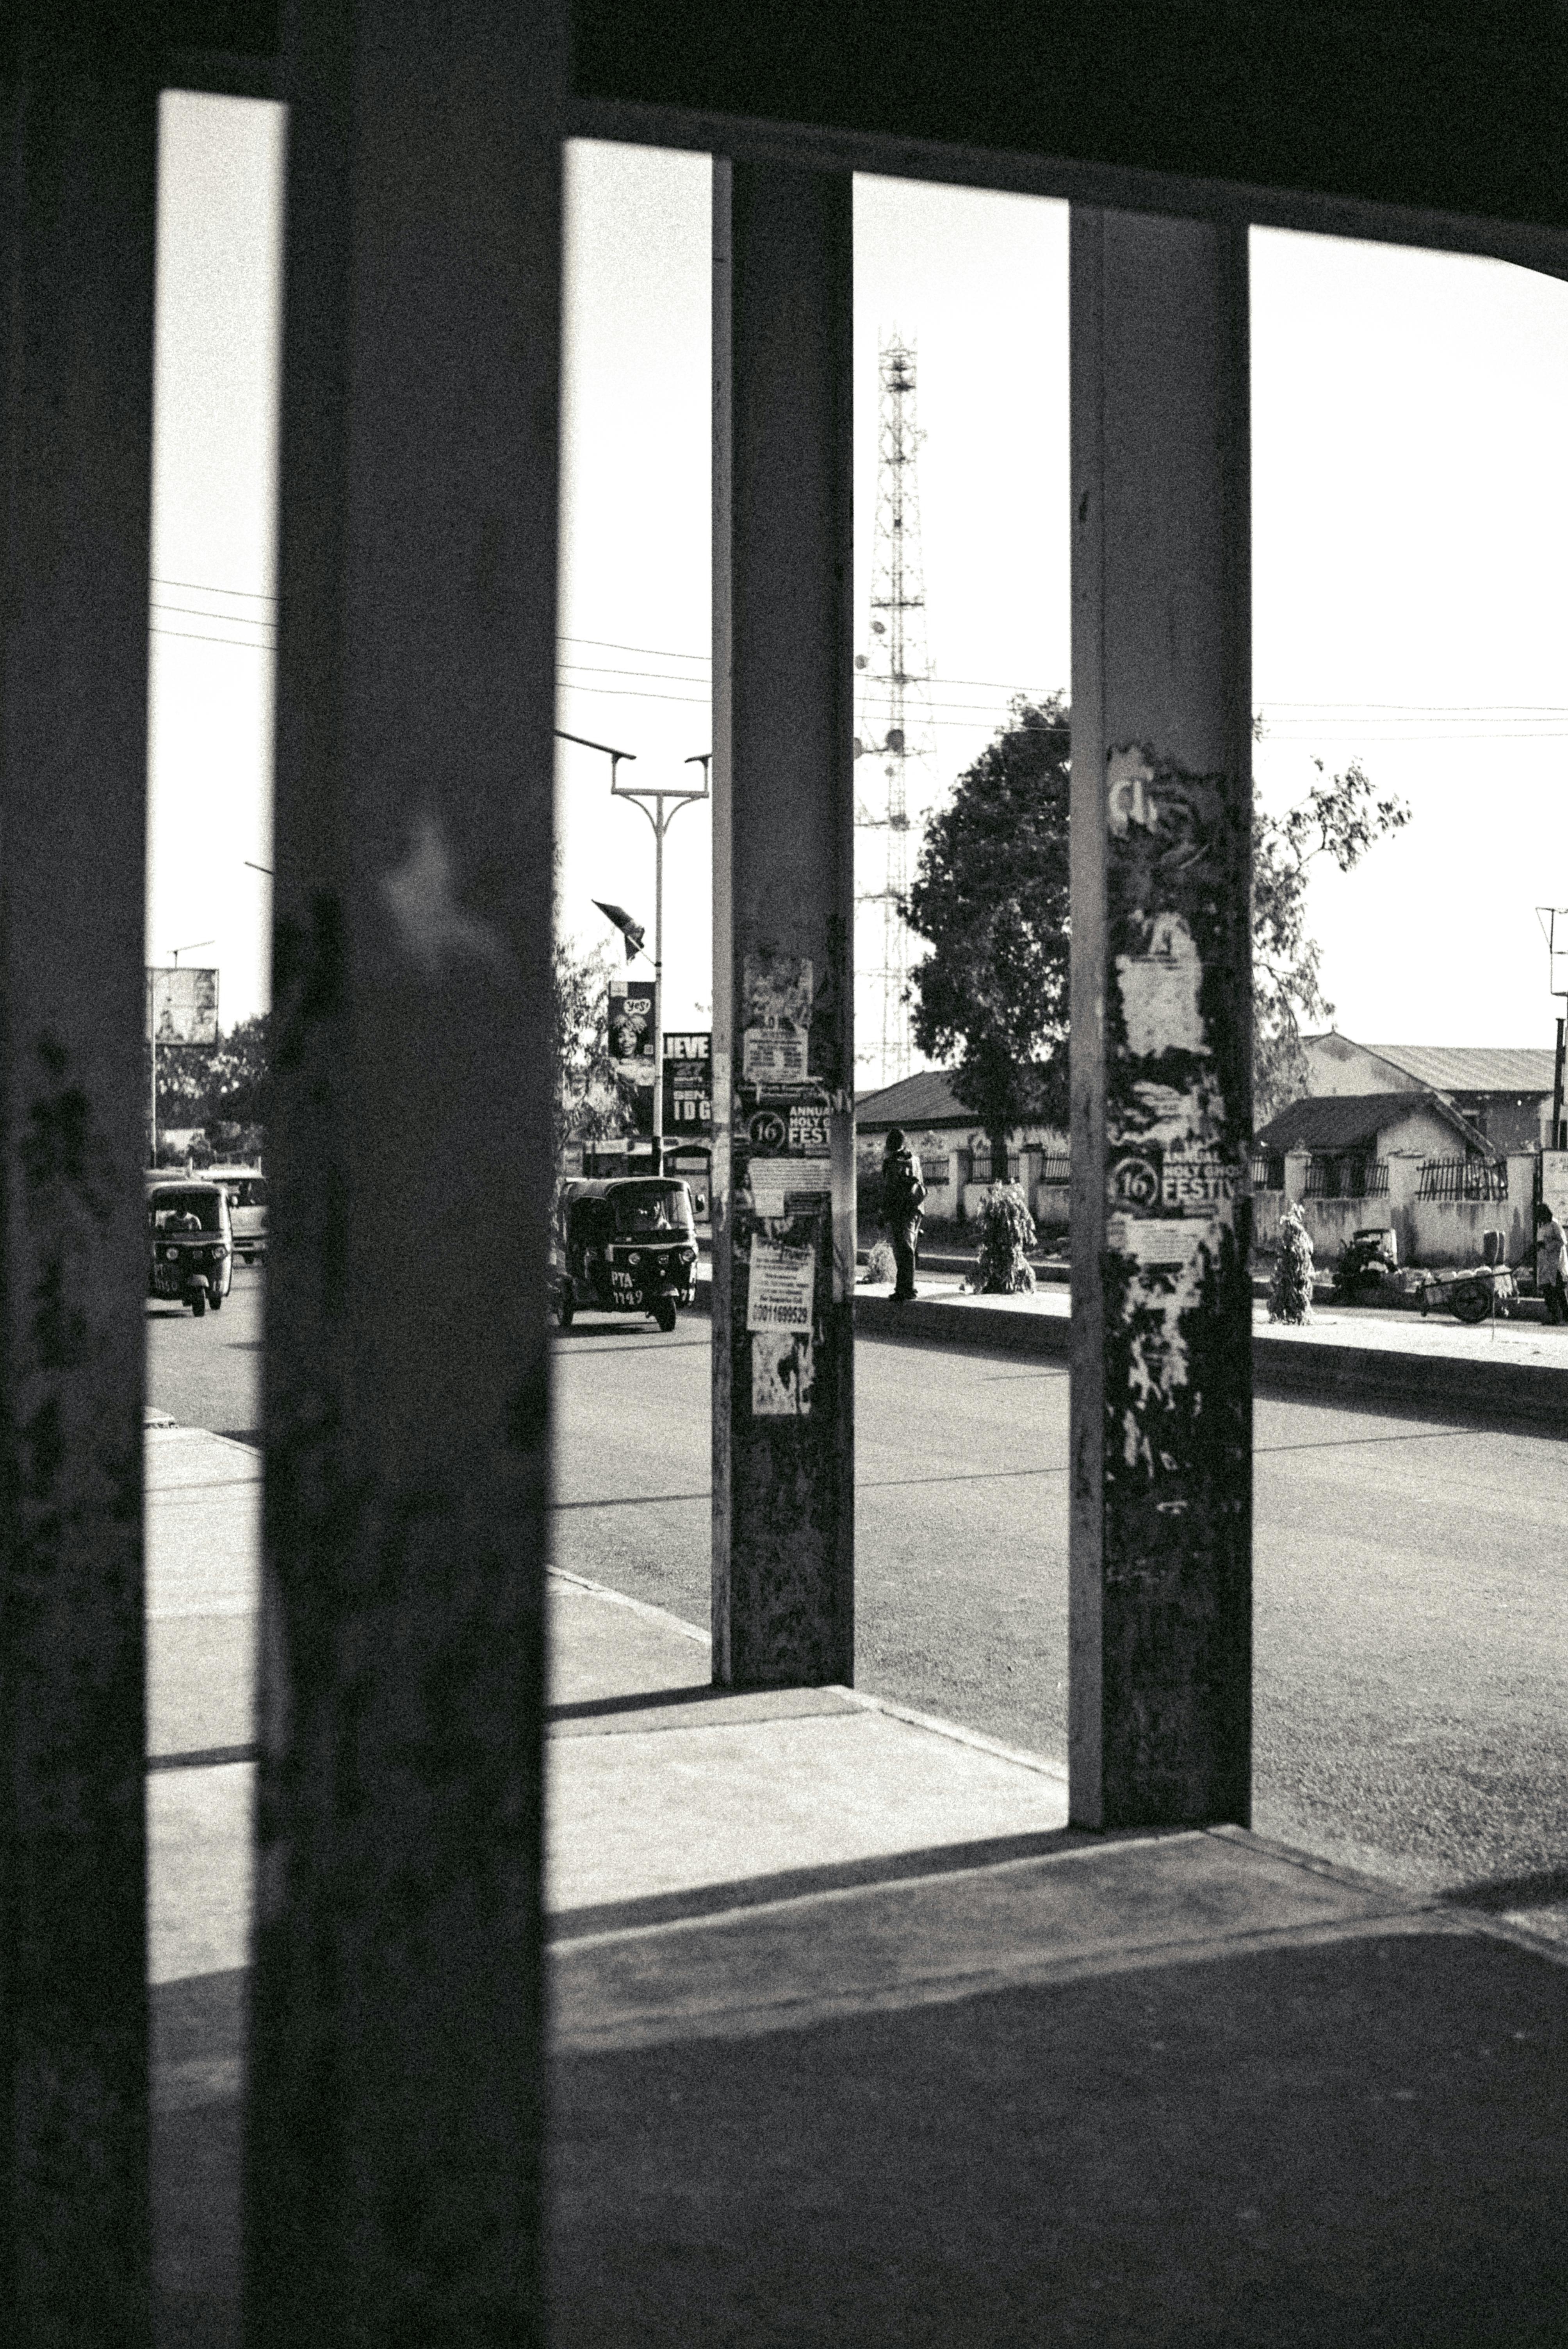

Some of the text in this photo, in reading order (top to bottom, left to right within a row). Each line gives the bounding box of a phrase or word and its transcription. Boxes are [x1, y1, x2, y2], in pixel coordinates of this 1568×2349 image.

[789, 1116, 820, 1127] HOLY
[757, 1123, 777, 1141] 16
[1162, 1165, 1242, 1178] HOLY GHO
[1123, 1172, 1148, 1198] 16
